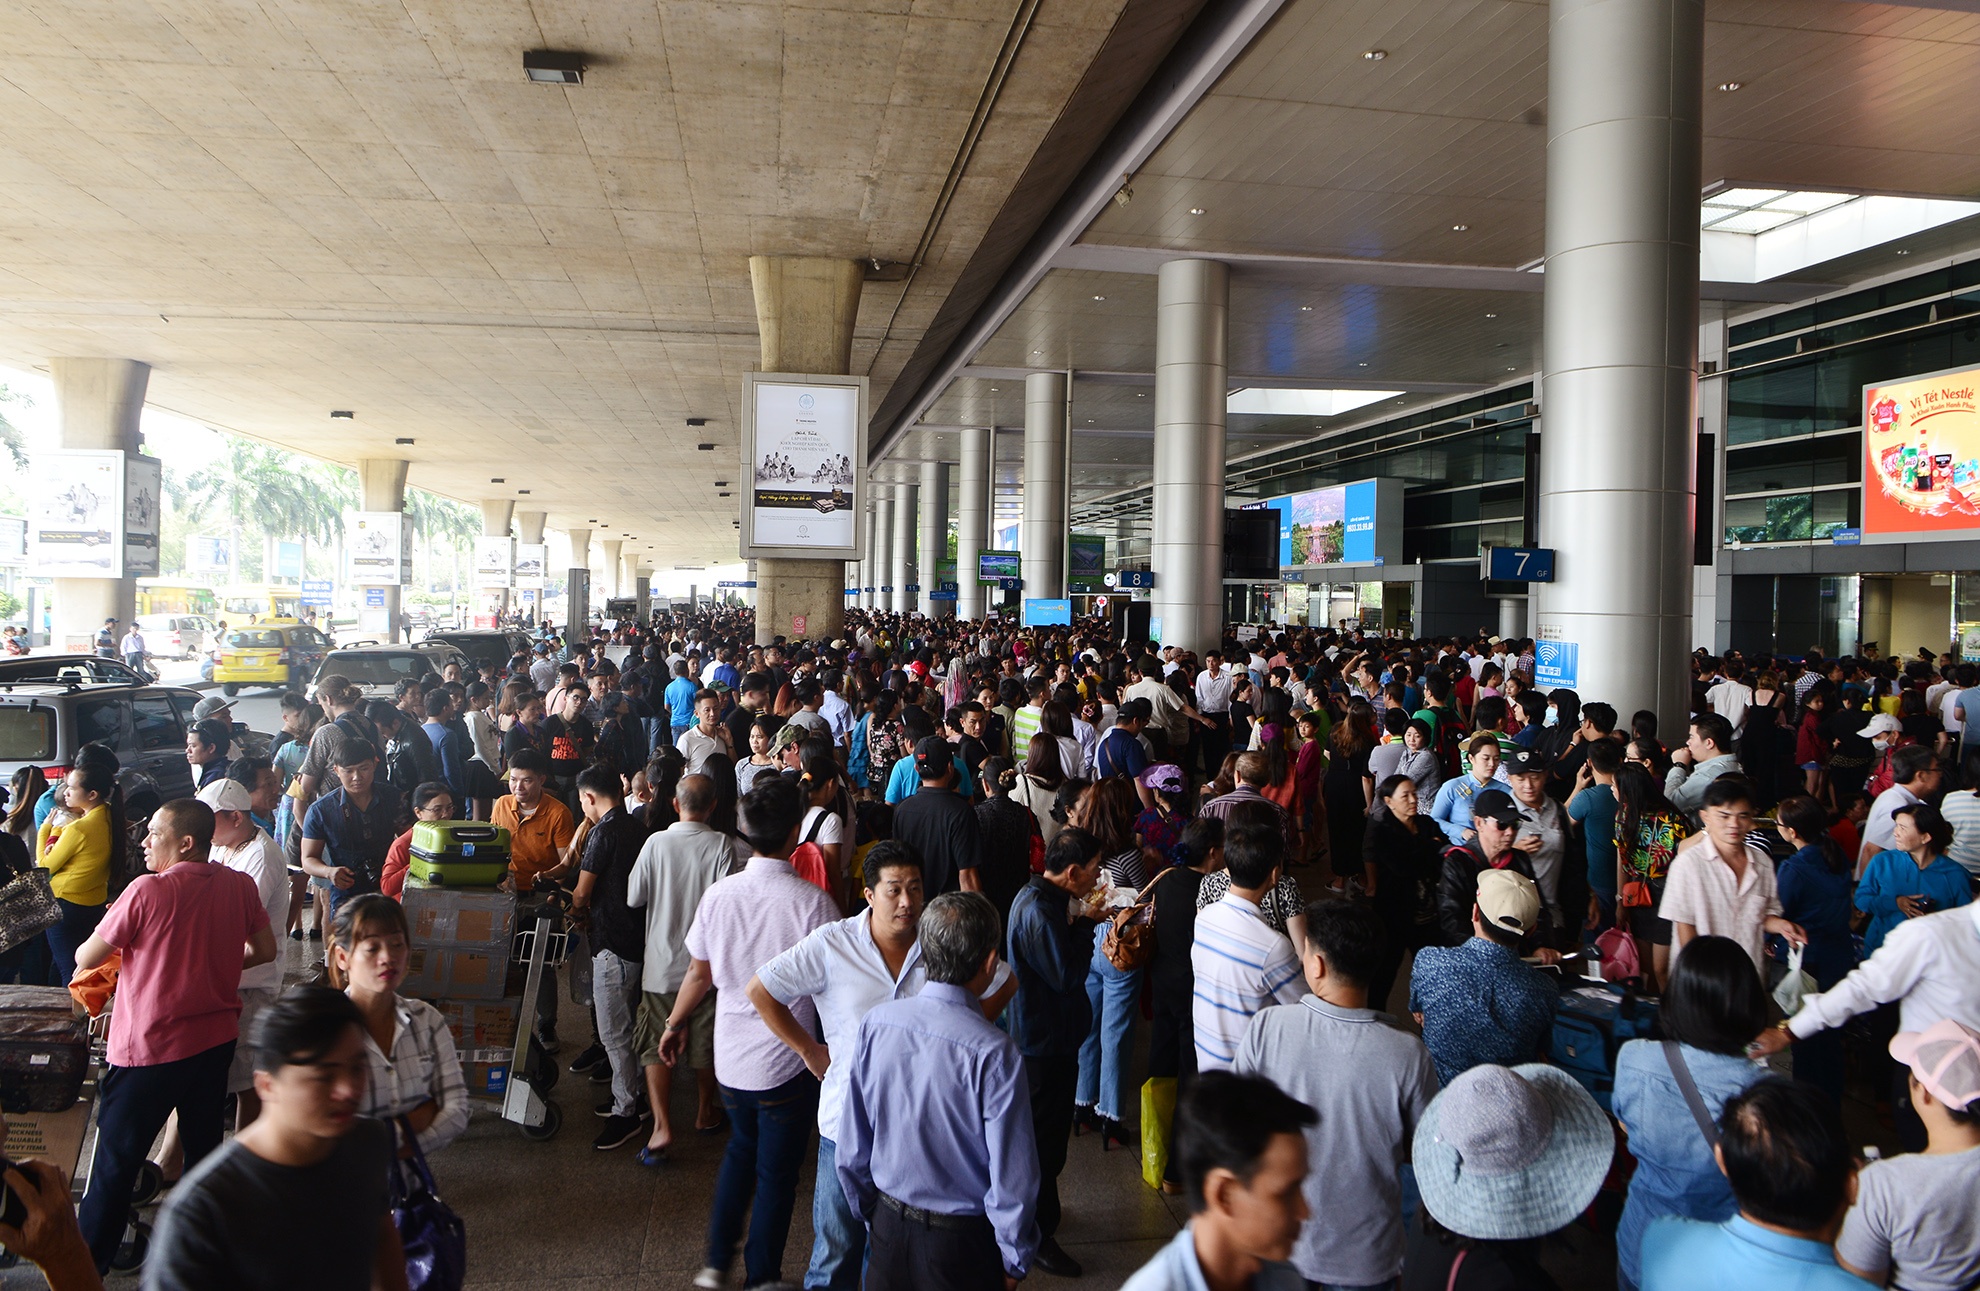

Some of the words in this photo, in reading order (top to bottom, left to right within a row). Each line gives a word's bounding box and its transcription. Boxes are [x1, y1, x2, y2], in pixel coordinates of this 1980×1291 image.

[1910, 397, 1921, 410] Vị
[1923, 390, 1938, 404] Tết
[1941, 387, 1975, 400] Nestlé
[1513, 552, 1531, 577] 7
[1536, 569, 1548, 578] GF
[1132, 573, 1141, 586] 8
[944, 583, 953, 591] 10
[1007, 580, 1014, 589] 9
[67, 644, 88, 652] PCCC
[1551, 678, 1574, 686] EXPRESS
